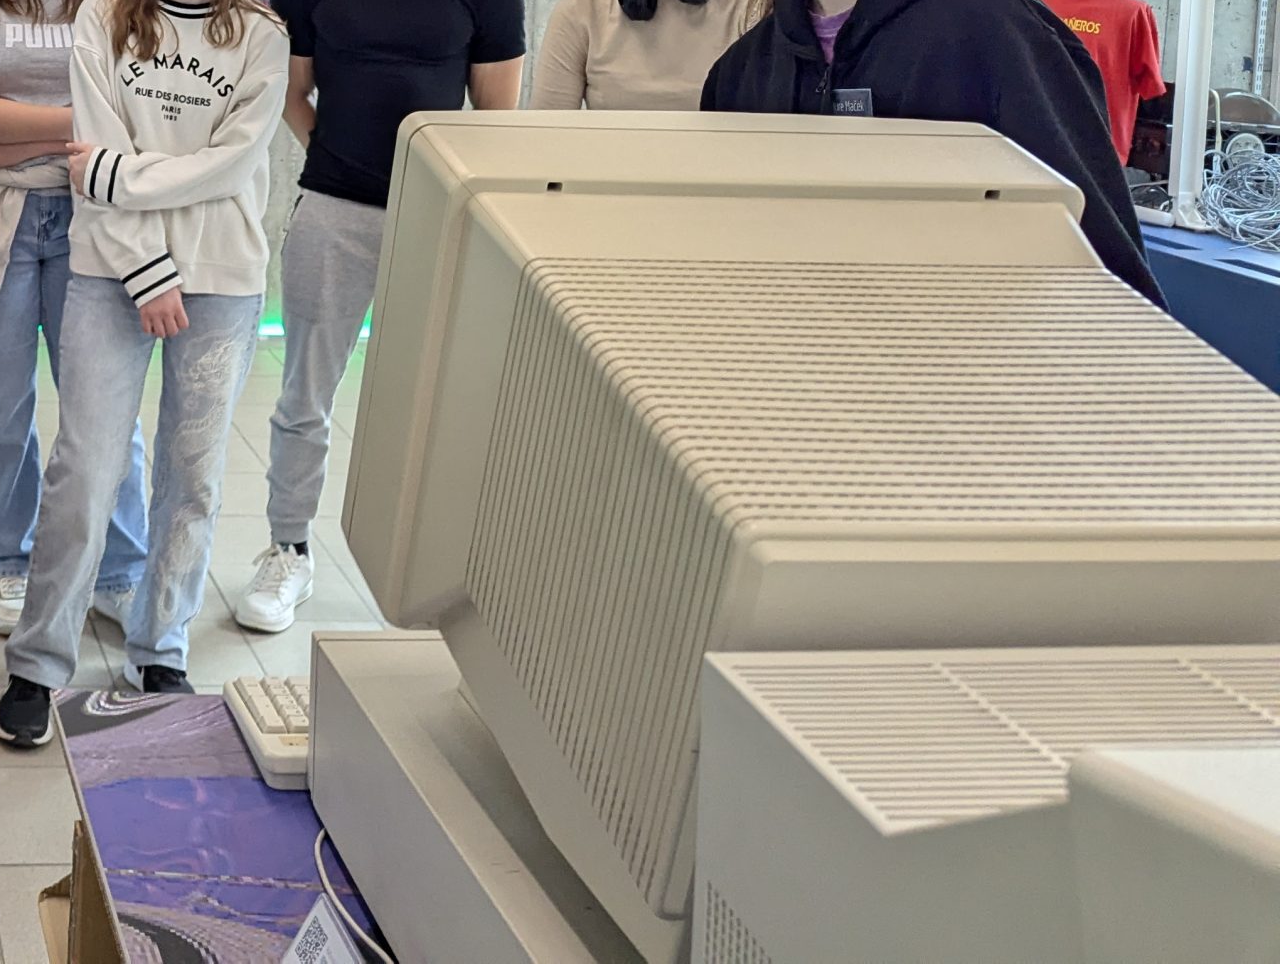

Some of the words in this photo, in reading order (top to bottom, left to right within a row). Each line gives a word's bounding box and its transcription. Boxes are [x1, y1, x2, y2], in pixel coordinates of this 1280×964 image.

[5, 23, 73, 48] PUM
[120, 61, 145, 87] LE
[153, 53, 234, 97] MARAIS
[135, 87, 153, 98] RUE
[155, 90, 172, 101] DES
[173, 94, 211, 107] ROSIERS
[161, 104, 182, 115] PARIS
